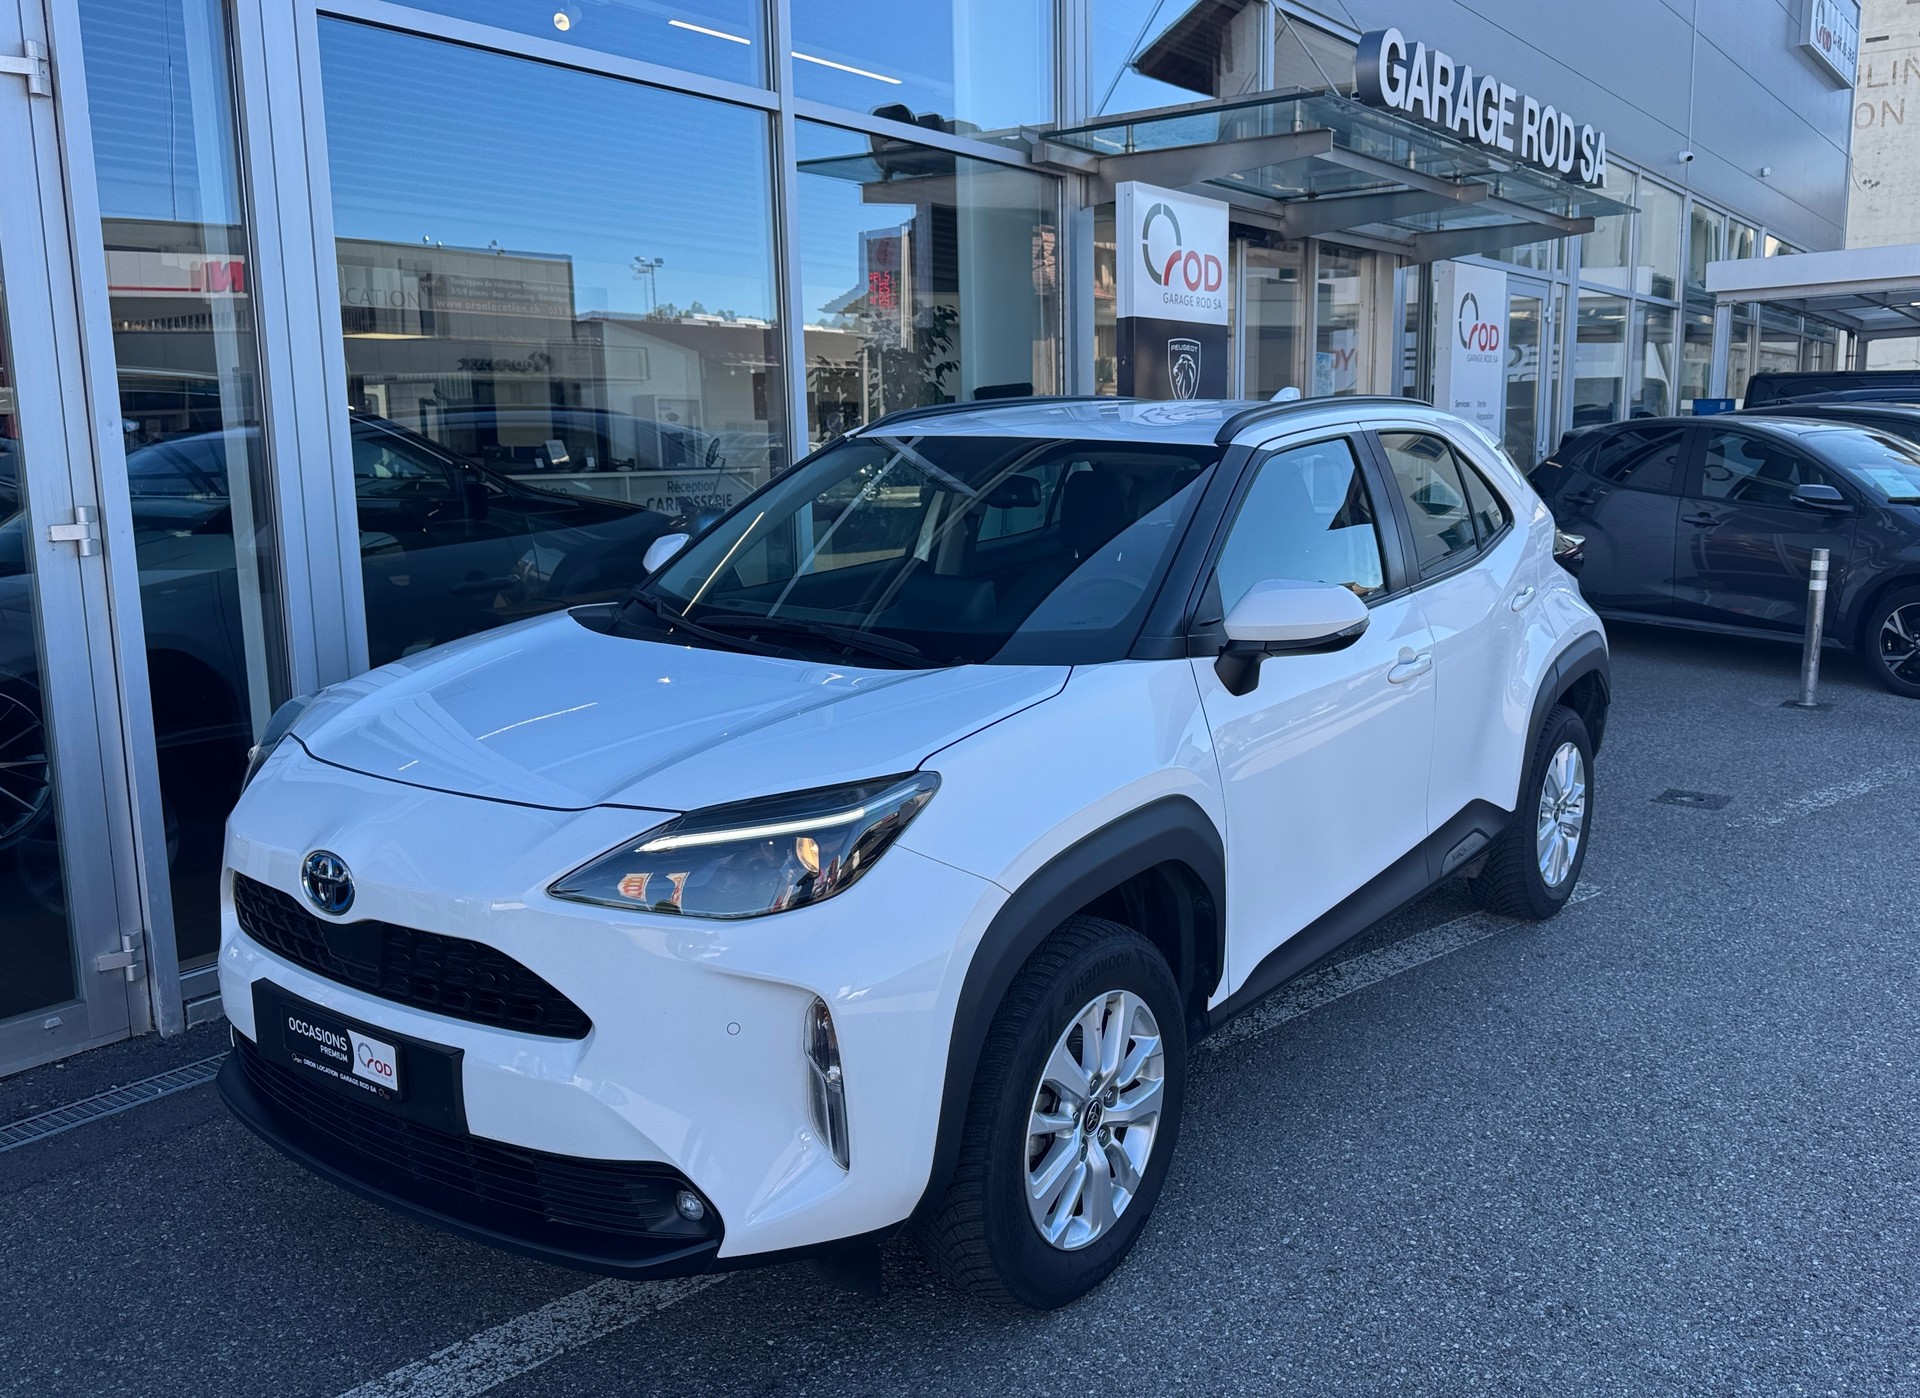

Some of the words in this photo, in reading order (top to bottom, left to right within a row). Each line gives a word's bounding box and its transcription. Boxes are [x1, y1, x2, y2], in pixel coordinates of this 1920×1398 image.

[1379, 27, 1516, 152] GARAGE
[1521, 95, 1575, 174] ROD
[1580, 123, 1607, 188] SA
[1163, 292, 1194, 308] GARAGE
[1196, 296, 1211, 310] ROD
[1213, 299, 1222, 311] SA
[1171, 344, 1198, 352] PEUGEOT
[667, 480, 716, 494] Réception
[288, 1016, 348, 1052] OCCASIONS
[320, 1044, 348, 1063] PREMIUM
[316, 1063, 339, 1078] LOCATION
[340, 1073, 359, 1087] GARAGE
[359, 1081, 370, 1091] ROD
[370, 1085, 377, 1094] SA
